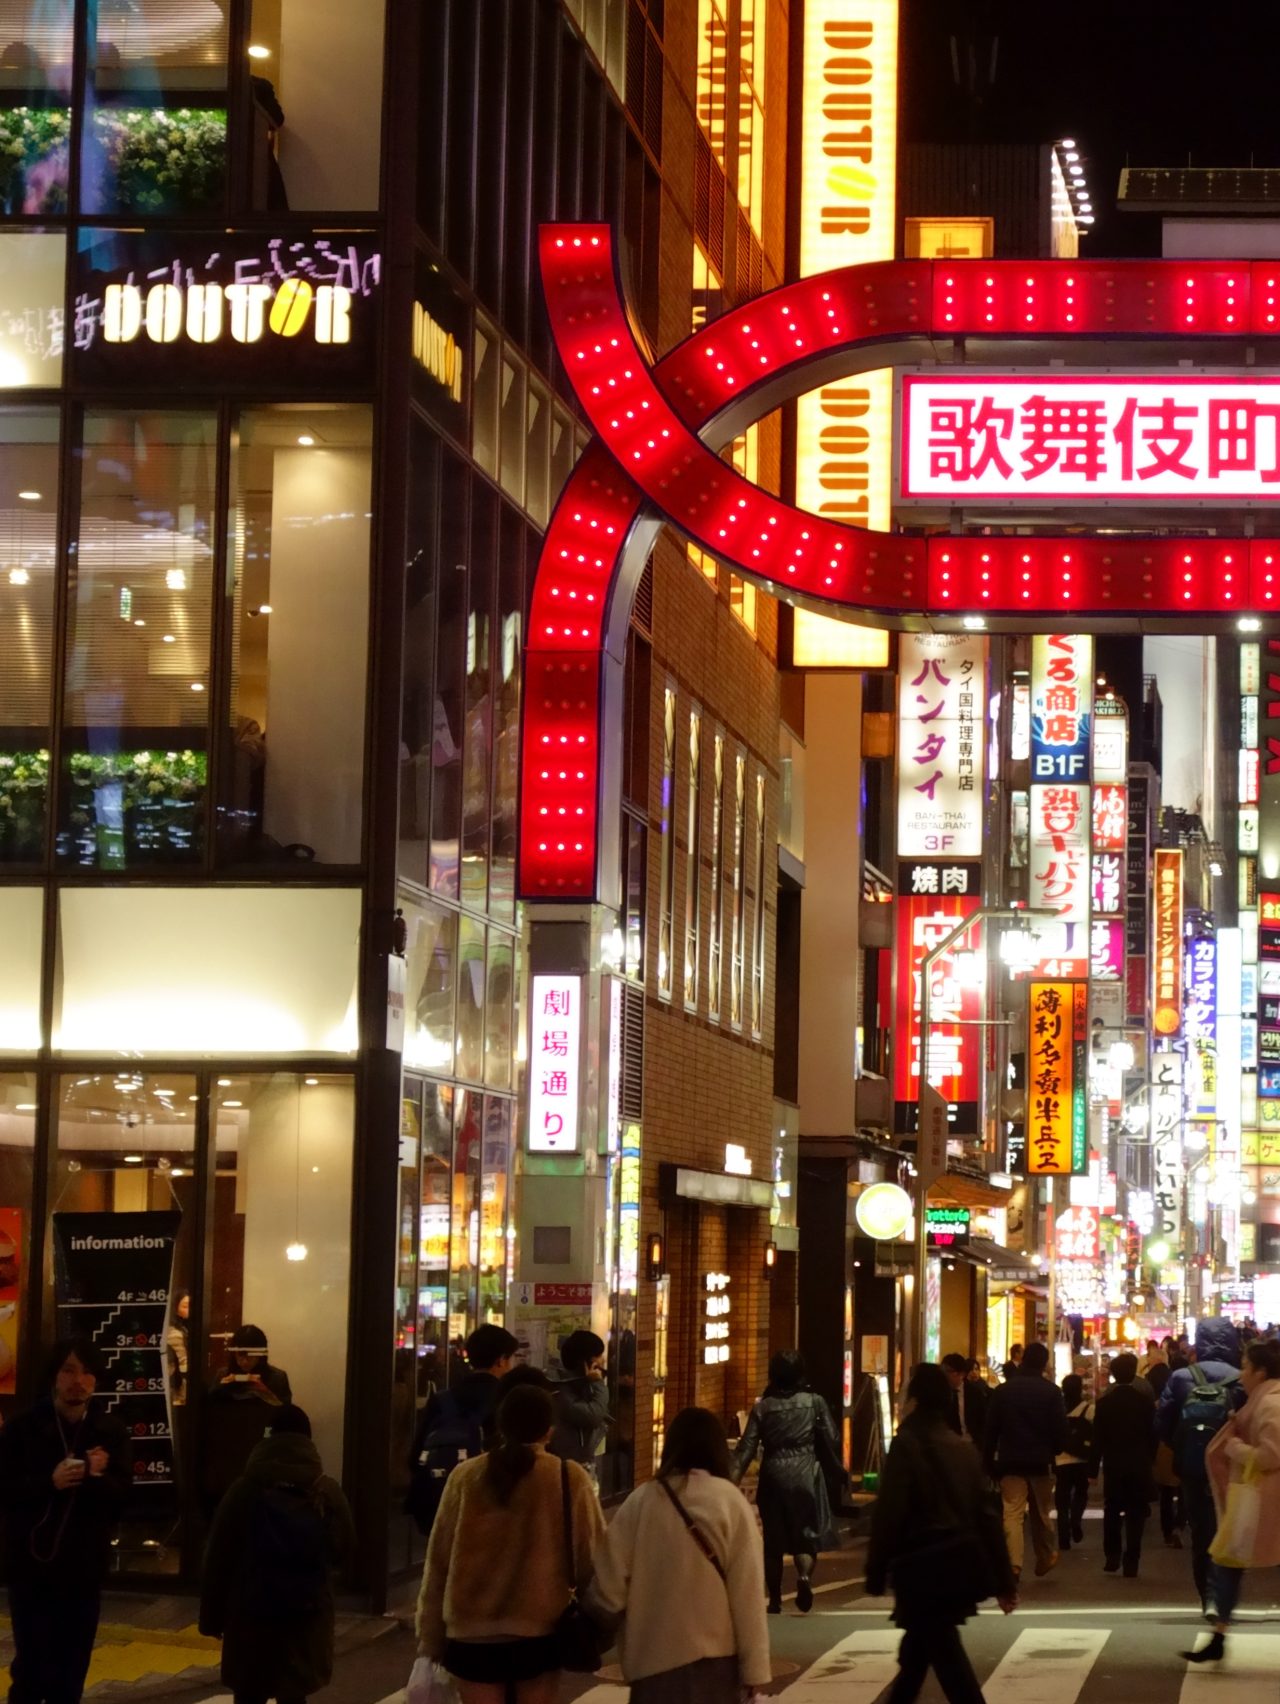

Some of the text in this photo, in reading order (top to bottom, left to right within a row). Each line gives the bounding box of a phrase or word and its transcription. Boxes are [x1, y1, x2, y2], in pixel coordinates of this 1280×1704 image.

[821, 21, 877, 234] DOUTOR
[104, 278, 351, 344] DOUTOR
[911, 659, 951, 800] バンタイ
[958, 660, 974, 791] タイ国料理専門店
[1036, 755, 1085, 775] B1F
[925, 835, 955, 850] 3F
[912, 866, 968, 893] 焼肉
[1042, 959, 1073, 977] 4F
[541, 988, 571, 1137] 劇場通り
[71, 1236, 164, 1250] information
[117, 1290, 165, 1301] 4F 46
[117, 1335, 133, 1346] 3F
[116, 1379, 165, 1391] 2F 53
[149, 1424, 164, 1435] 12
[147, 1462, 164, 1473] 45
